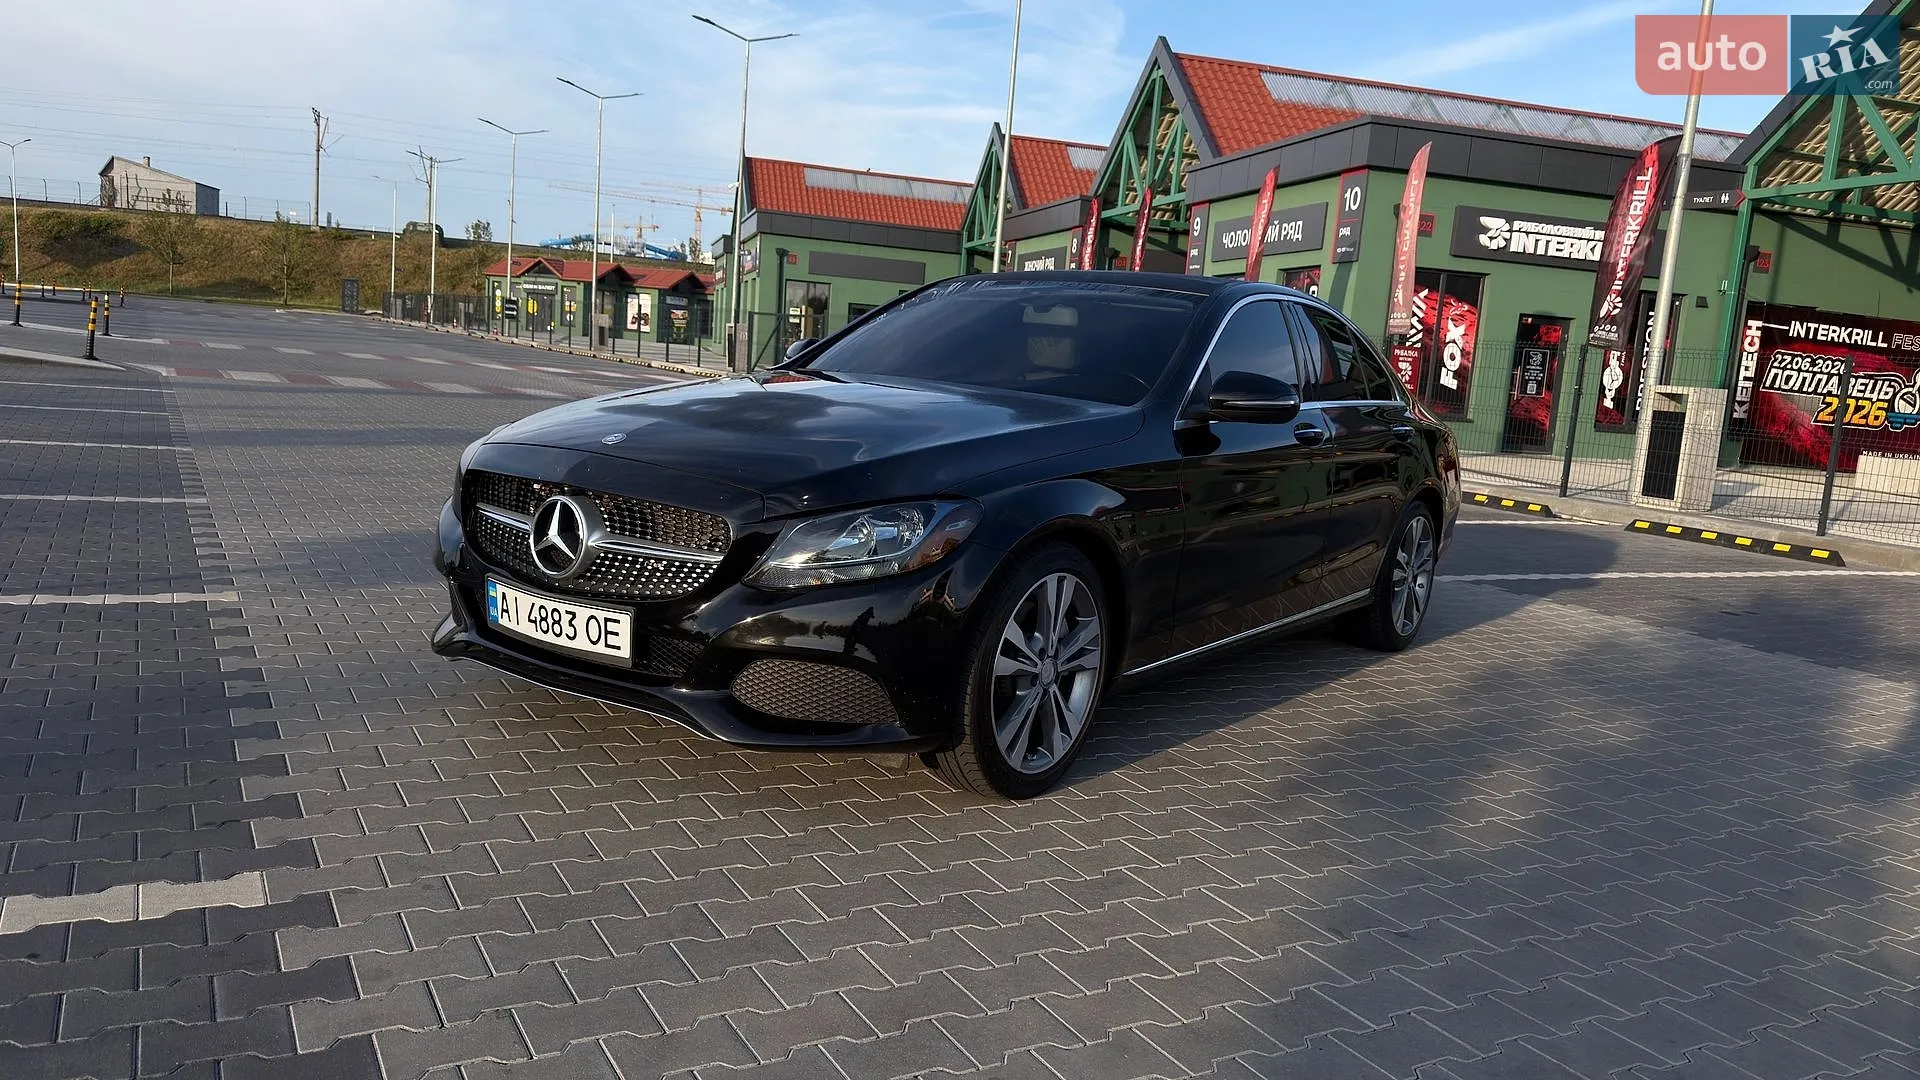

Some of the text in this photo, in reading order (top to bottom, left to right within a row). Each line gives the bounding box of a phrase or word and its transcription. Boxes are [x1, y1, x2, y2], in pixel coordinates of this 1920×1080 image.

[1344, 186, 1361, 212] 10
[1193, 216, 1201, 237] 9
[1222, 220, 1303, 249] ЧОЛОИЙ РЯД
[1512, 220, 1595, 240] РИБОЛОВНИЙ
[1071, 238, 1078, 254] 8
[1788, 320, 1888, 347] INTERKRILL
[1440, 316, 1466, 390] FOX
[1733, 319, 1763, 419] KEITECH
[1765, 368, 1894, 401] ПОПЛАВЕЦЬ
[490, 591, 622, 651] UA AI 4883 OE
